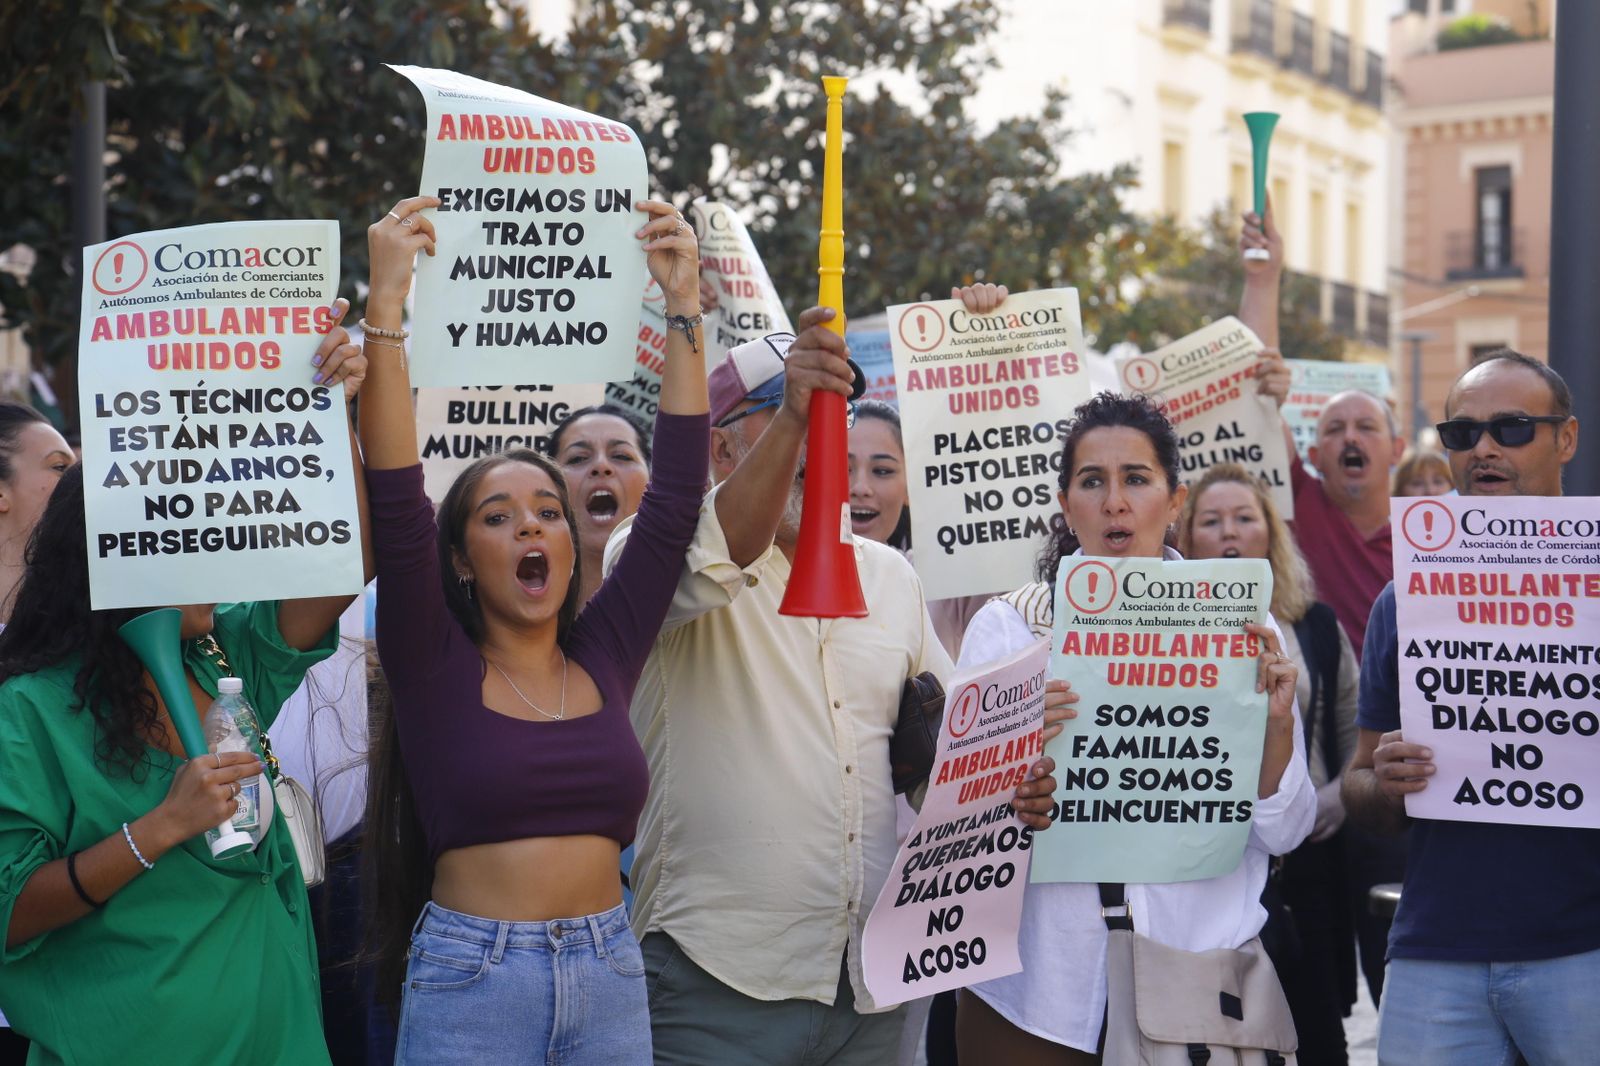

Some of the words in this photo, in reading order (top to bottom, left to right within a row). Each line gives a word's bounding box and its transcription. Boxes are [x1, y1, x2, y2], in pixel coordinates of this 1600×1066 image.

[437, 114, 632, 144] AMBULANTES
[483, 147, 596, 174] UNIDOS
[437, 187, 586, 214] EXIGIMOS
[594, 188, 632, 213] UN
[482, 222, 584, 247] TRATO
[154, 243, 322, 273] Comacor
[450, 254, 612, 281] MUNICIPAL
[152, 272, 219, 288] Asociación
[223, 270, 238, 282] de
[241, 270, 324, 282] Comerciantes
[99, 293, 170, 310] Autónomos
[173, 288, 247, 301] Ambulantes
[250, 288, 266, 299] de
[269, 286, 322, 299] Córdoba
[480, 288, 575, 314] JUSTO
[90, 305, 335, 342] AMBULANTES
[446, 322, 468, 348] Y
[476, 321, 608, 348] HUMANO
[949, 307, 1062, 334] Comacor
[910, 352, 964, 364] Autónomos
[966, 346, 1014, 358] Ambulantes
[1015, 344, 1025, 354] de
[1026, 340, 1067, 352] Córdoba
[950, 335, 996, 346] Asociación
[997, 333, 1007, 342] de
[1009, 328, 1067, 340] Comerciantes
[147, 340, 282, 372] UNIDOS
[906, 352, 1080, 392] AMBULANTES
[95, 390, 162, 418] LOS
[169, 380, 332, 415] TÉCNICOS
[448, 400, 570, 426] BULLING
[949, 384, 1040, 415] UNIDOS
[1170, 387, 1242, 425] UNIDOS
[108, 414, 219, 452] ESTÁN
[228, 420, 324, 450] PARA
[934, 419, 1072, 456] PLACEROS
[1214, 421, 1245, 442] AL
[102, 454, 334, 490] AYUDARNOS,
[925, 451, 1063, 488] PISTOLERO
[1181, 444, 1263, 472] ULLING
[144, 494, 194, 522] NO
[204, 487, 302, 518] PARA
[964, 490, 1004, 514] NO
[1012, 484, 1052, 508] OS
[937, 512, 1065, 554] QUEREMO
[1460, 508, 1600, 538] Comaco
[98, 519, 352, 558] PERSEGUIRNOS
[1459, 538, 1518, 550] Asociación
[1520, 539, 1534, 550] de
[1537, 539, 1600, 551] Comerciant
[1411, 553, 1475, 564] Autónomos
[1478, 554, 1542, 566] Ambulantes
[1544, 554, 1558, 565] de
[1122, 572, 1258, 600] Comacor
[1408, 571, 1600, 598] AMBULANTE
[1072, 615, 1132, 626] Autónomos
[1135, 616, 1196, 628] Ambulantes
[1198, 617, 1211, 628] de
[1118, 601, 1175, 612] Asociación
[1177, 602, 1190, 612] de
[1192, 602, 1258, 612] Comerciantes
[1457, 601, 1574, 628] UNIDOS
[1062, 631, 1260, 658] AMBULANTES
[1107, 662, 1219, 688] UNIDOS
[982, 668, 1046, 713] Comacor
[978, 710, 1010, 728] Asociación
[1012, 706, 1019, 716] de
[1094, 704, 1210, 729] SOMOS
[1431, 697, 1600, 737] DIÁLOGO
[947, 734, 984, 752] Autónomos
[985, 721, 1021, 740] Ambulantes
[1022, 716, 1029, 726] de
[935, 728, 1044, 786] AMBULANTE
[1072, 735, 1230, 764] FAMILIAS,
[1490, 742, 1544, 772] NO
[957, 763, 1028, 805] UNIDOS
[1066, 767, 1110, 792] NO
[1118, 767, 1233, 792] SOMOS
[1453, 776, 1584, 811] ACOSO
[906, 802, 1016, 850] AYUNTAMIEN
[902, 825, 1034, 880] QUEREMOS
[894, 862, 1016, 908] DIÁLOGO
[926, 904, 964, 938] NO
[902, 937, 988, 985] ACOSO
